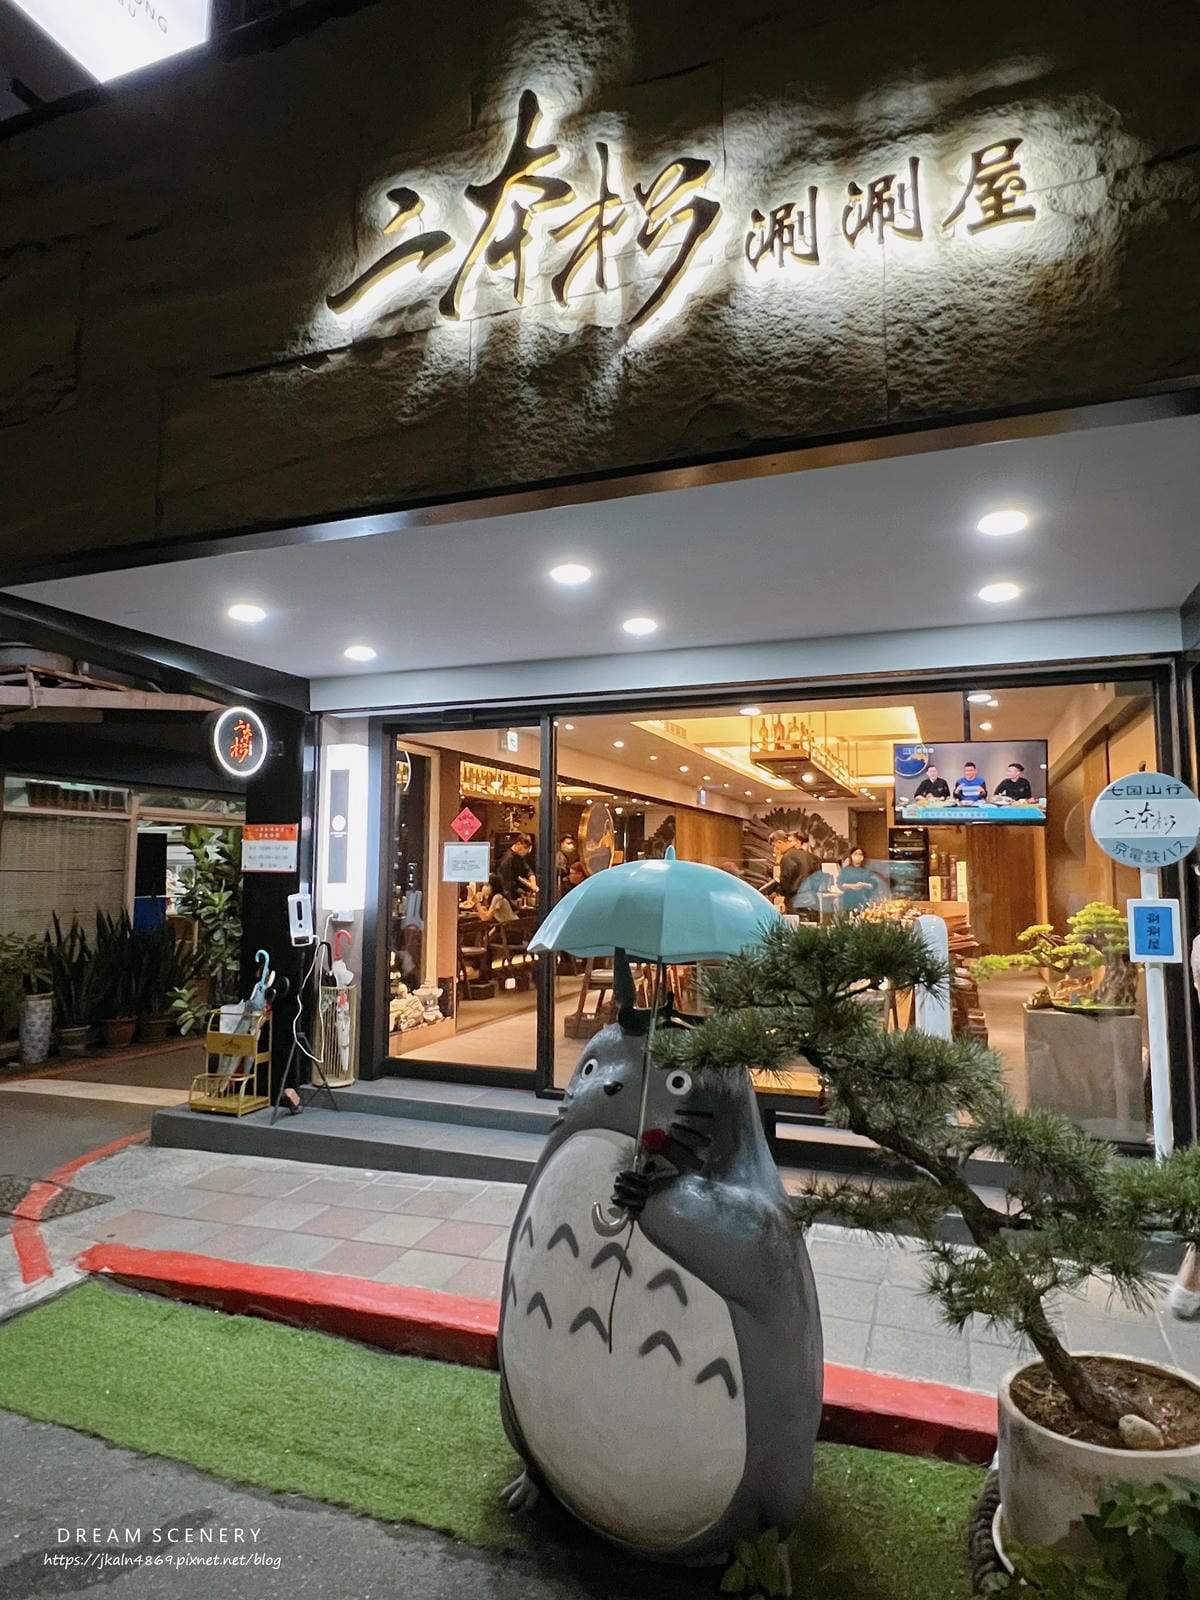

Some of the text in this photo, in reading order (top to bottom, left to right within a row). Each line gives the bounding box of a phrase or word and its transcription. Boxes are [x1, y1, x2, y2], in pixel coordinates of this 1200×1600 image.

[743, 137, 1037, 272] 涮涮屋
[1107, 783, 1183, 796] 七国山行
